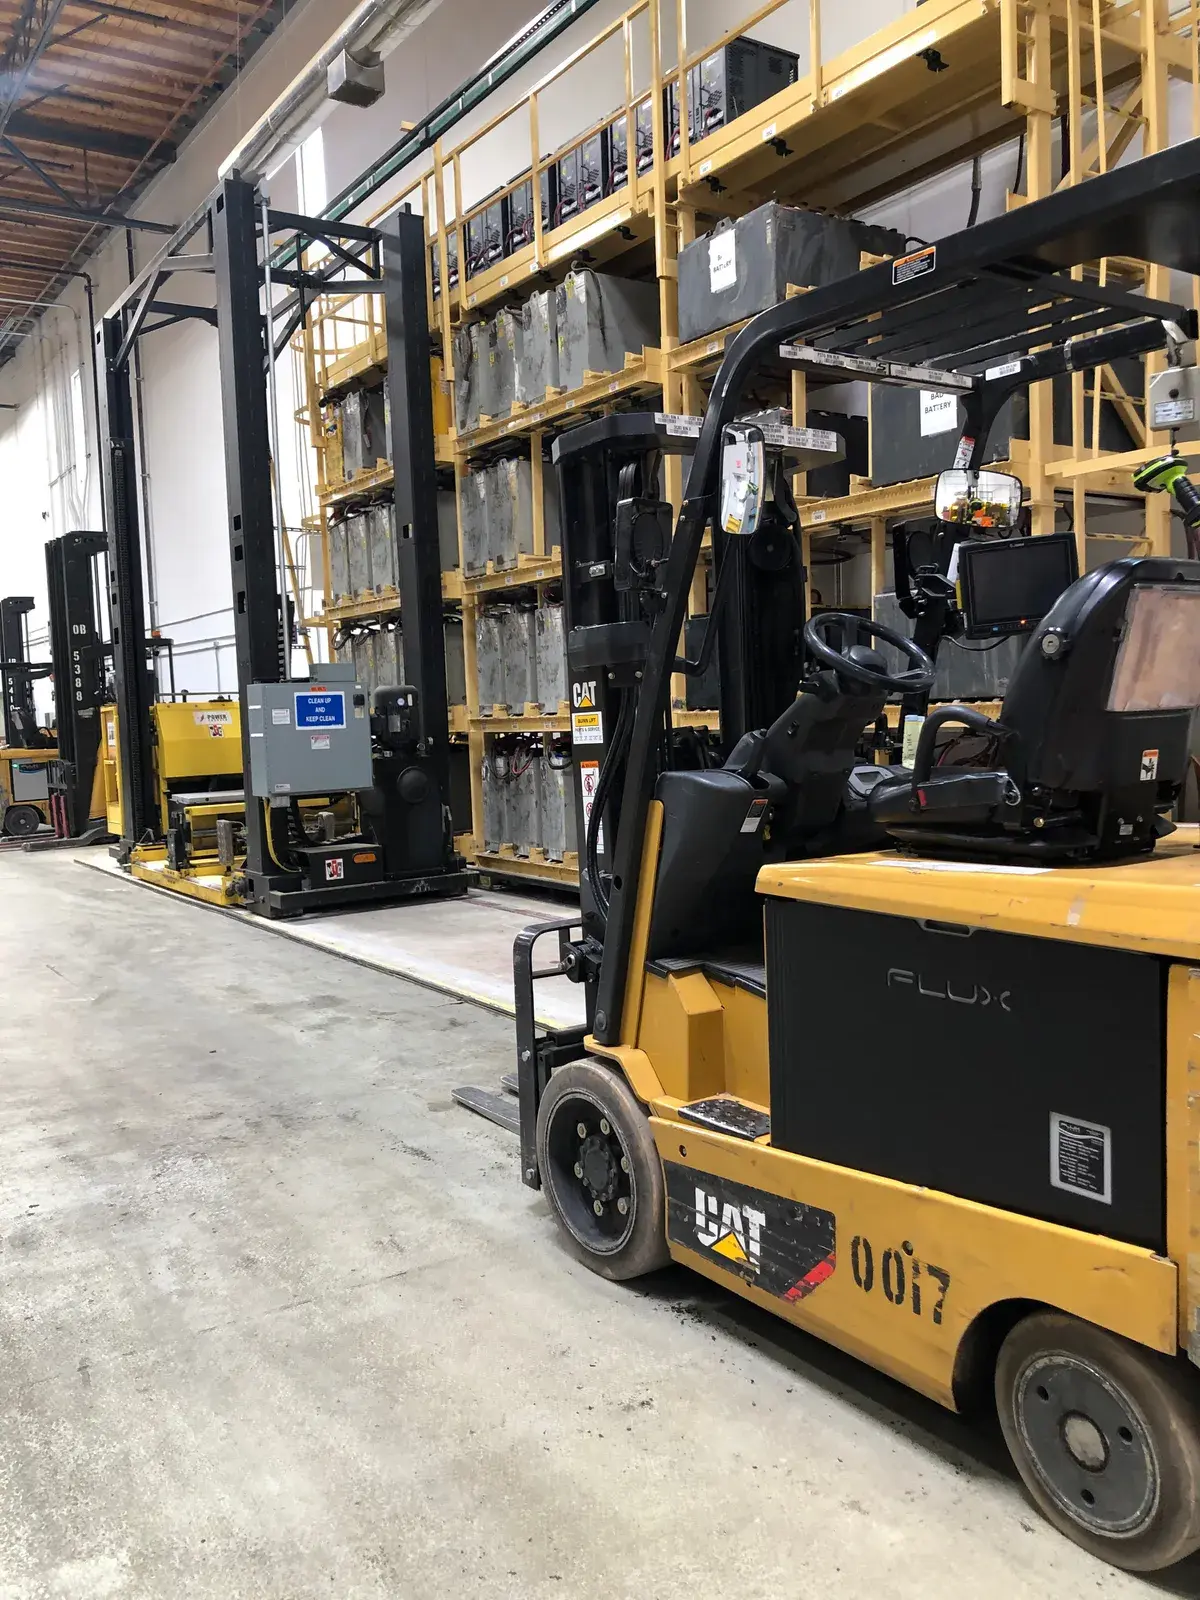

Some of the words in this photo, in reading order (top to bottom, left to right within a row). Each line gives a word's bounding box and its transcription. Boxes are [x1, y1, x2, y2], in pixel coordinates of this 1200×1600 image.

[925, 401, 952, 414] BATTERY
[73, 651, 83, 701] 5388
[572, 681, 597, 708] CAT
[887, 967, 1012, 1012] FLUX
[695, 1187, 766, 1275] CAT
[851, 1235, 951, 1326] 0017
